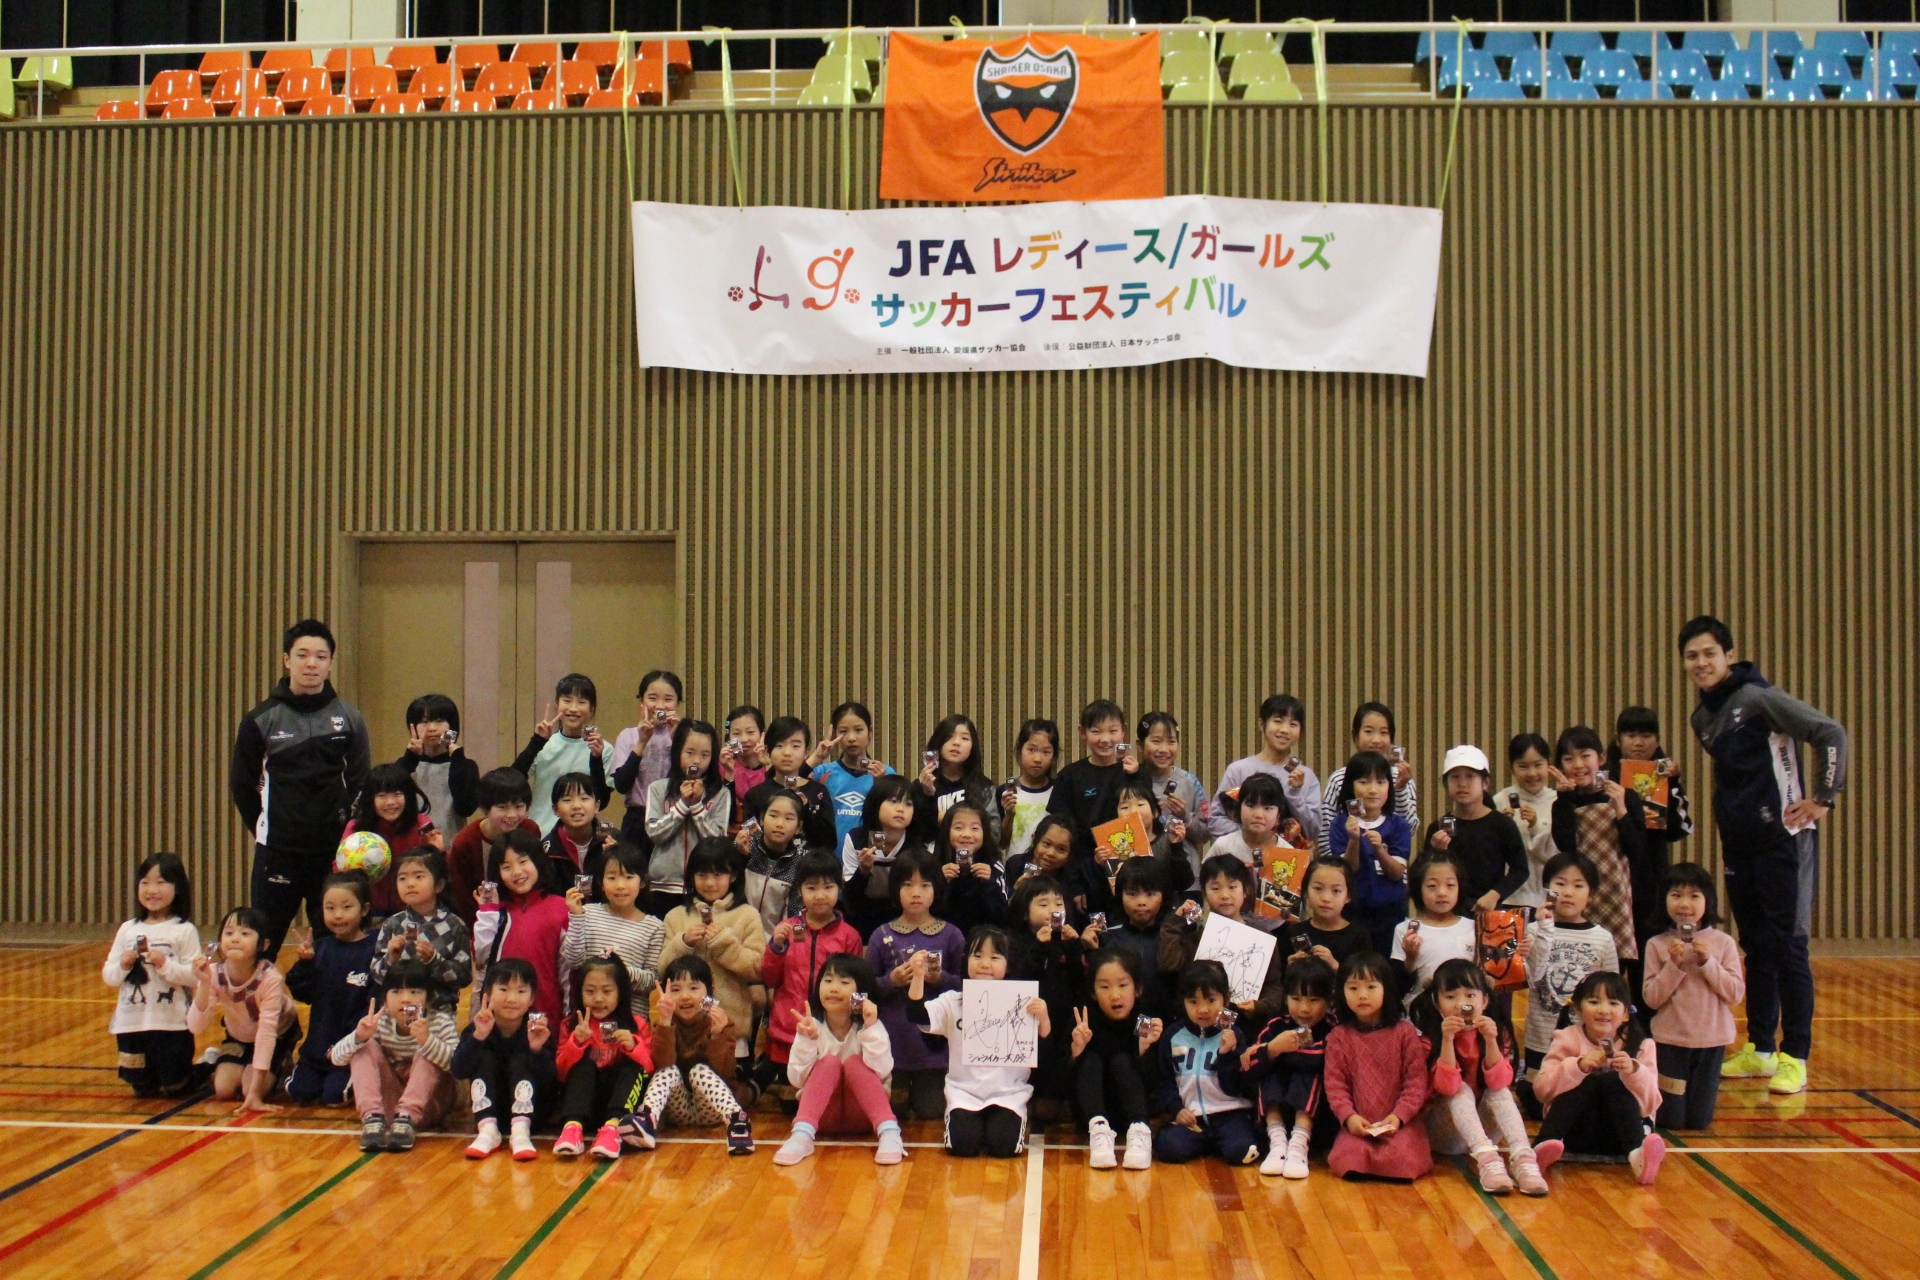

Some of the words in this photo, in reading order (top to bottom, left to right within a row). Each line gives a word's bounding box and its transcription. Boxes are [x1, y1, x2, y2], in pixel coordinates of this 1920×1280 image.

[987, 62, 1031, 77] SHRIKER
[1033, 62, 1067, 75] OSAKA
[888, 238, 977, 278] JFA
[993, 222, 1336, 273] レディース/ガールズ
[871, 275, 1247, 329] サッカーフェスティバル
[1120, 332, 1182, 347] 日本サッカー協会
[837, 808, 863, 817] umbr
[1171, 1045, 1219, 1071] FIL
